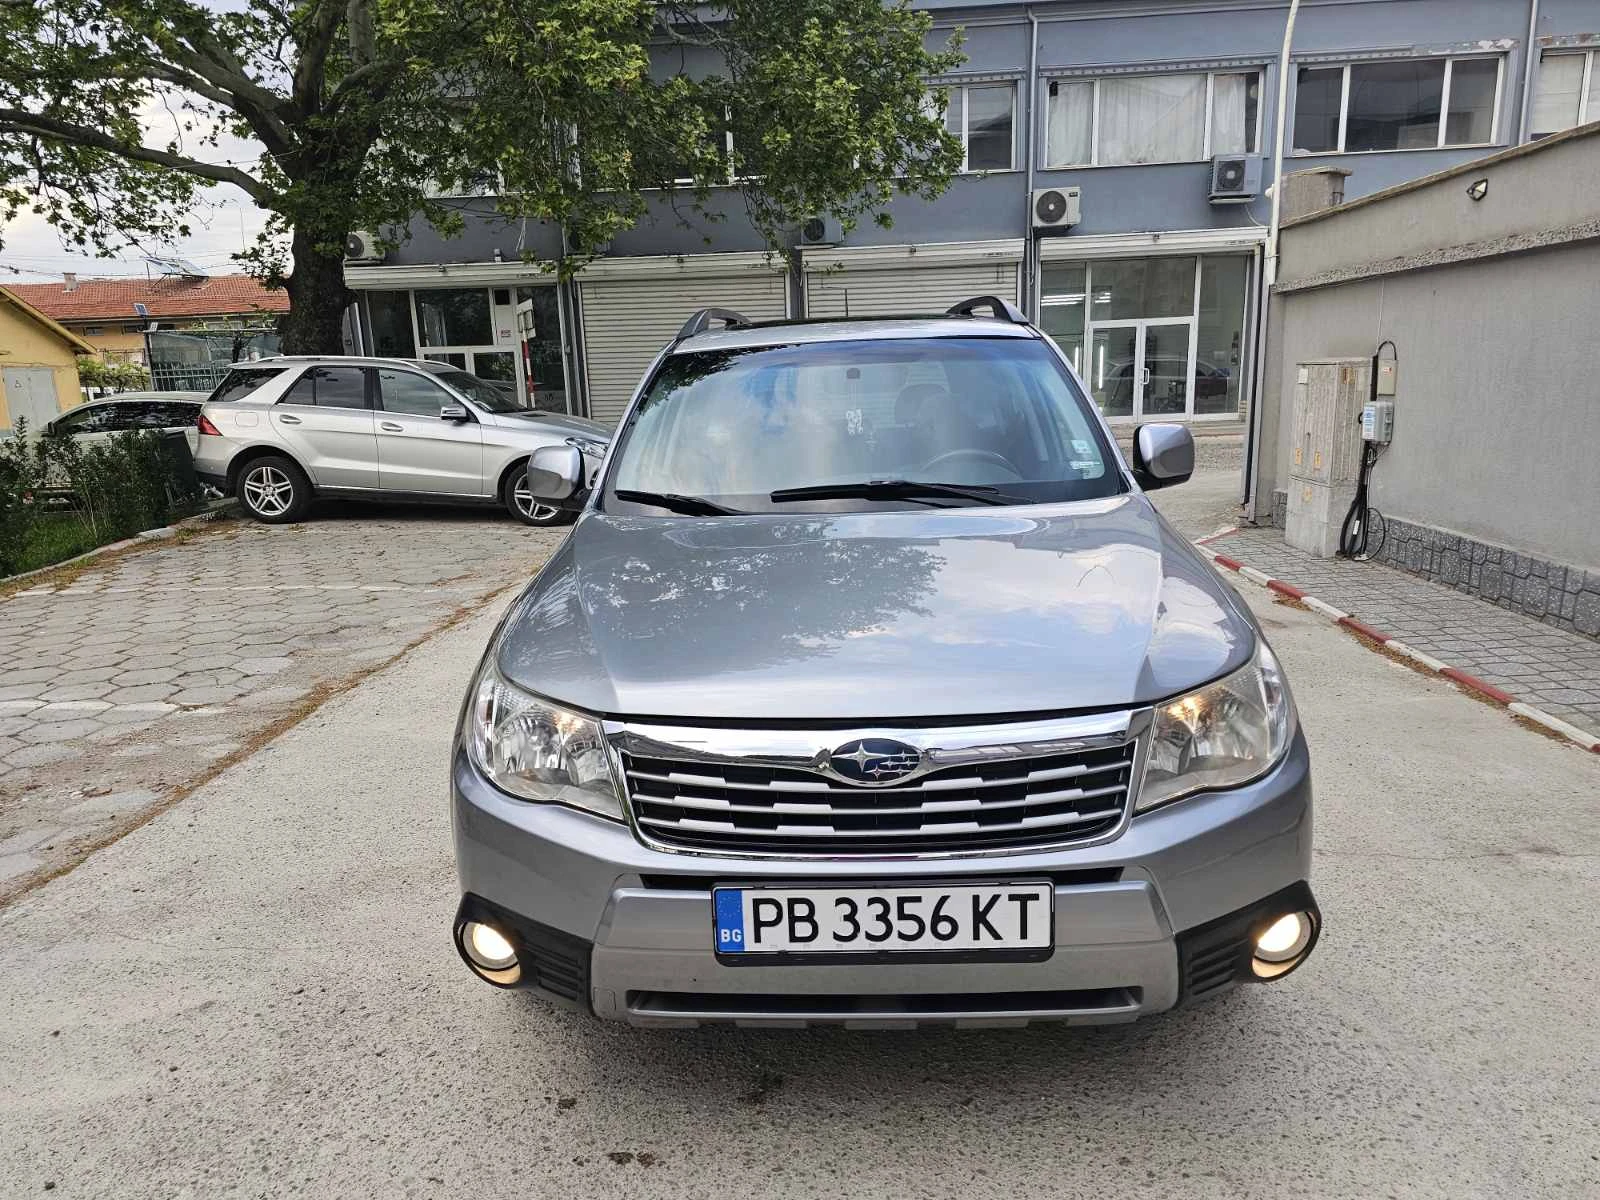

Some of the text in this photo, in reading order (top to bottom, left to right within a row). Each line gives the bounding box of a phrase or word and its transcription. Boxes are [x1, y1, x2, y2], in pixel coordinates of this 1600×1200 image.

[752, 893, 1040, 943] PB 3356 KT
[720, 928, 742, 943] BG
